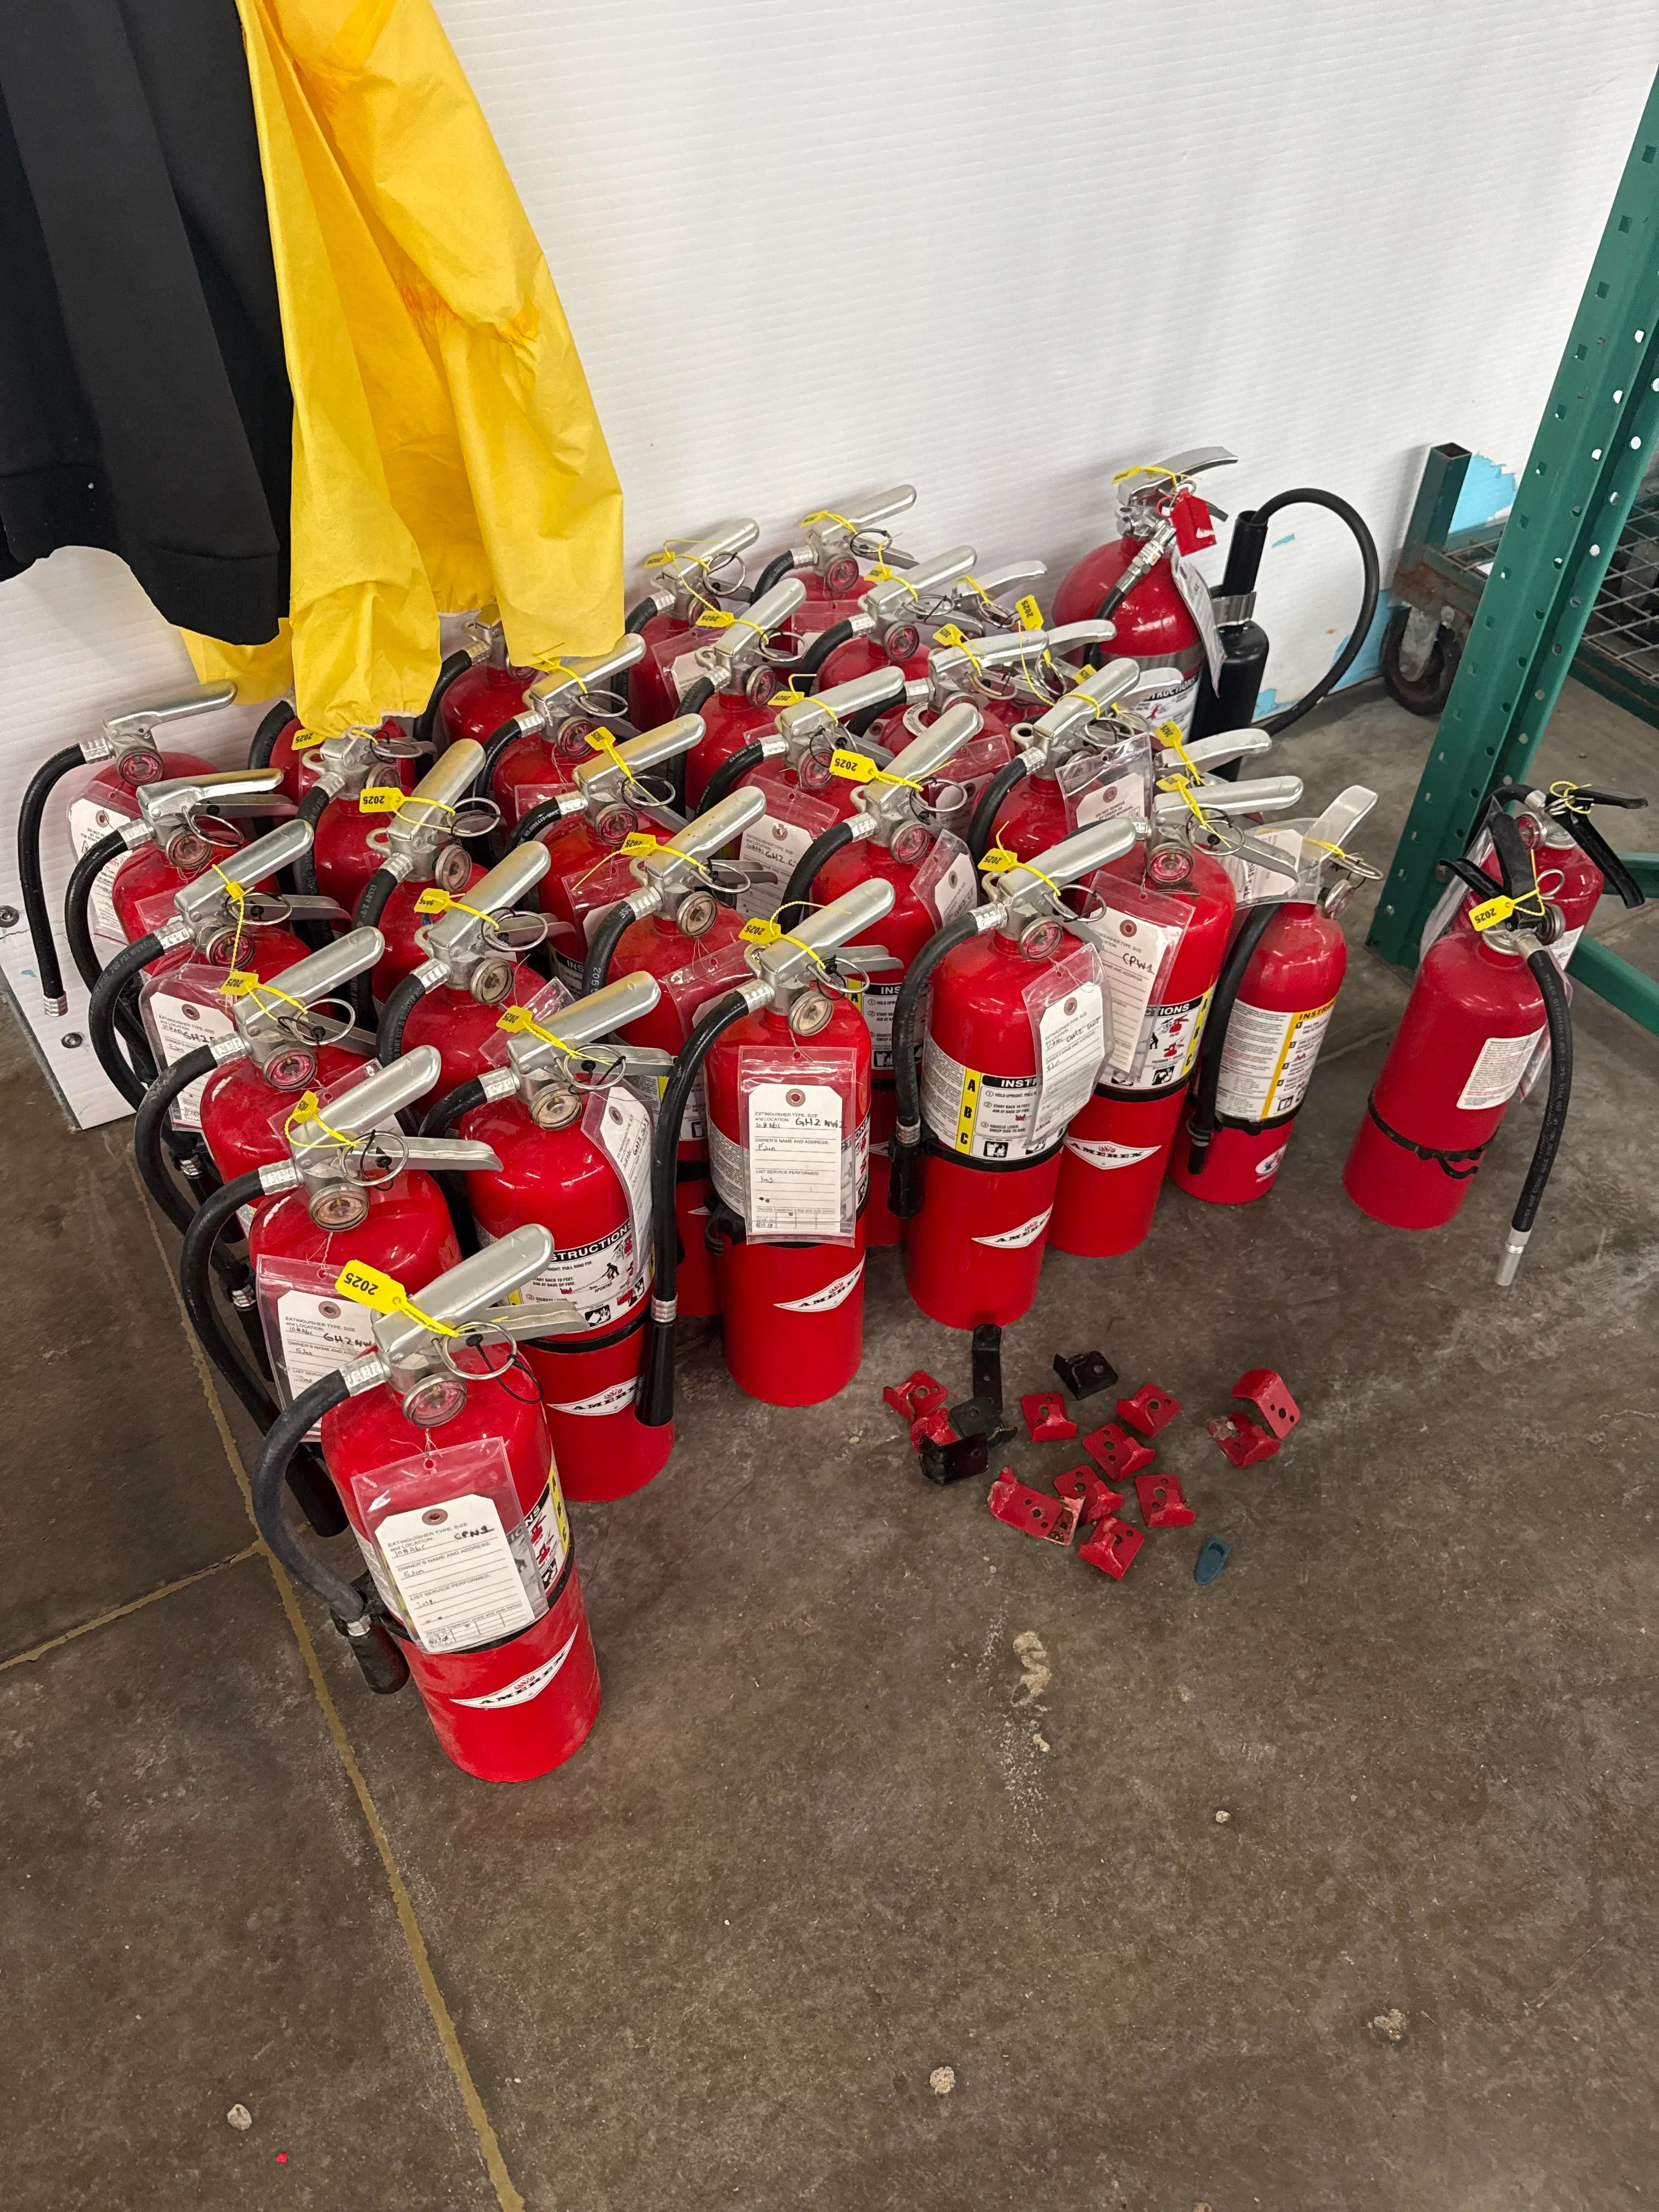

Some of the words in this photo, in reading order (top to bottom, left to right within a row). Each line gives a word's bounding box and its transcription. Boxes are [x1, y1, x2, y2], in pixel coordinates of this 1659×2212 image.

[1021, 600, 1033, 619] 2025
[295, 732, 313, 743] 2025
[591, 729, 604, 742] 2025
[835, 758, 858, 771] 2025
[363, 795, 385, 805] 2025
[625, 839, 643, 848] 2025
[985, 855, 1002, 865] 2025
[1474, 907, 1497, 925] 2025
[746, 925, 765, 935] 2025
[566, 960, 584, 973] INS
[1113, 966, 1122, 974] AND
[228, 978, 244, 988] 2025
[881, 986, 901, 995] INS
[501, 1012, 520, 1024] 2025
[967, 1079, 975, 1092] A
[964, 1105, 972, 1119] B
[795, 1117, 821, 1126] GH2
[960, 1132, 968, 1145] C
[1070, 1143, 1144, 1159] AMEREX
[344, 1271, 379, 1297] 2025
[595, 1282, 613, 1293] APUNTAR
[285, 1316, 326, 1327] EXTINGUISHER
[324, 1333, 354, 1346] GH2
[572, 1383, 637, 1410] AMERE
[388, 1532, 435, 1547] EXTINGUISHER
[397, 1561, 427, 1572] OWNER'S
[428, 1555, 445, 1564] NAME
[461, 1542, 492, 1554] ADDRESS:
[425, 1584, 450, 1596] SERVICE
[452, 1574, 491, 1589] PERFORMED:
[479, 1650, 566, 1705] AMEREX
